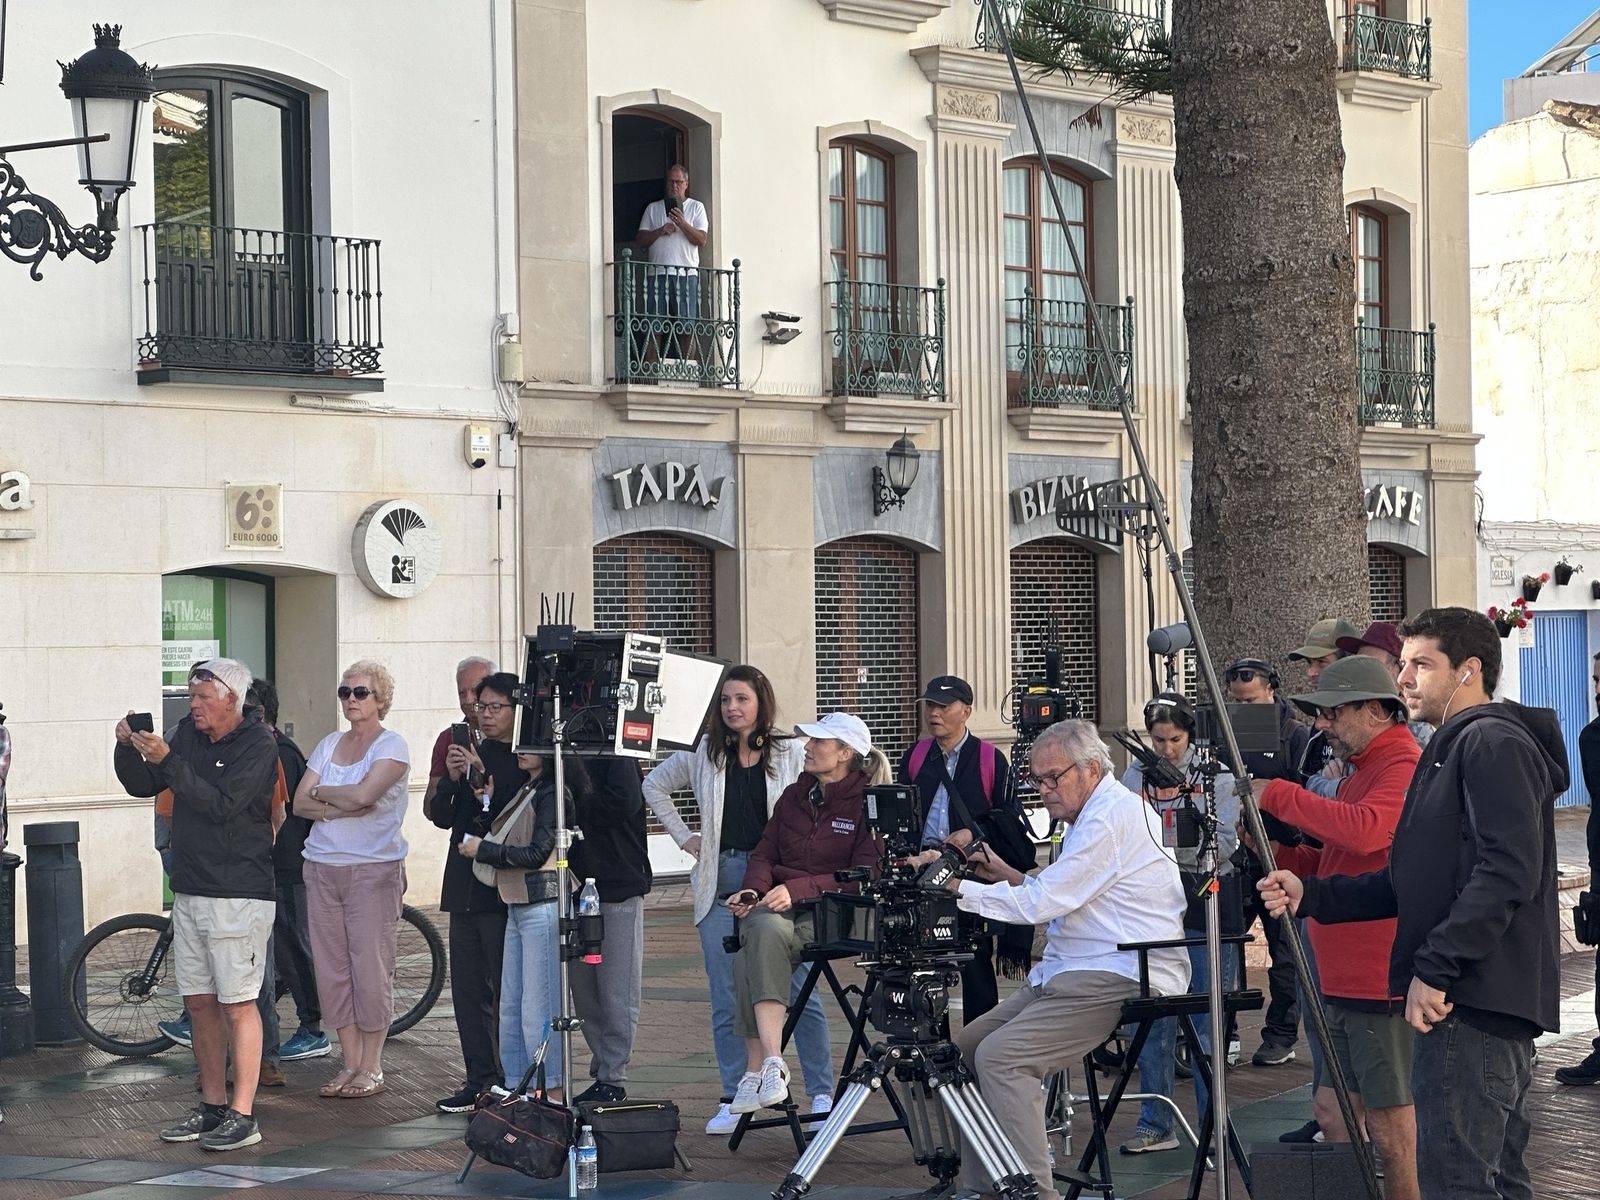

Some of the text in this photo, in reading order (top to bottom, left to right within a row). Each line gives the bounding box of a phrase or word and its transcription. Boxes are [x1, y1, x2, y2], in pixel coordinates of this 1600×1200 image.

[233, 532, 278, 542] EURO 6000
[1491, 569, 1513, 580] IGLESIA
[163, 599, 213, 622] ATM 24H
